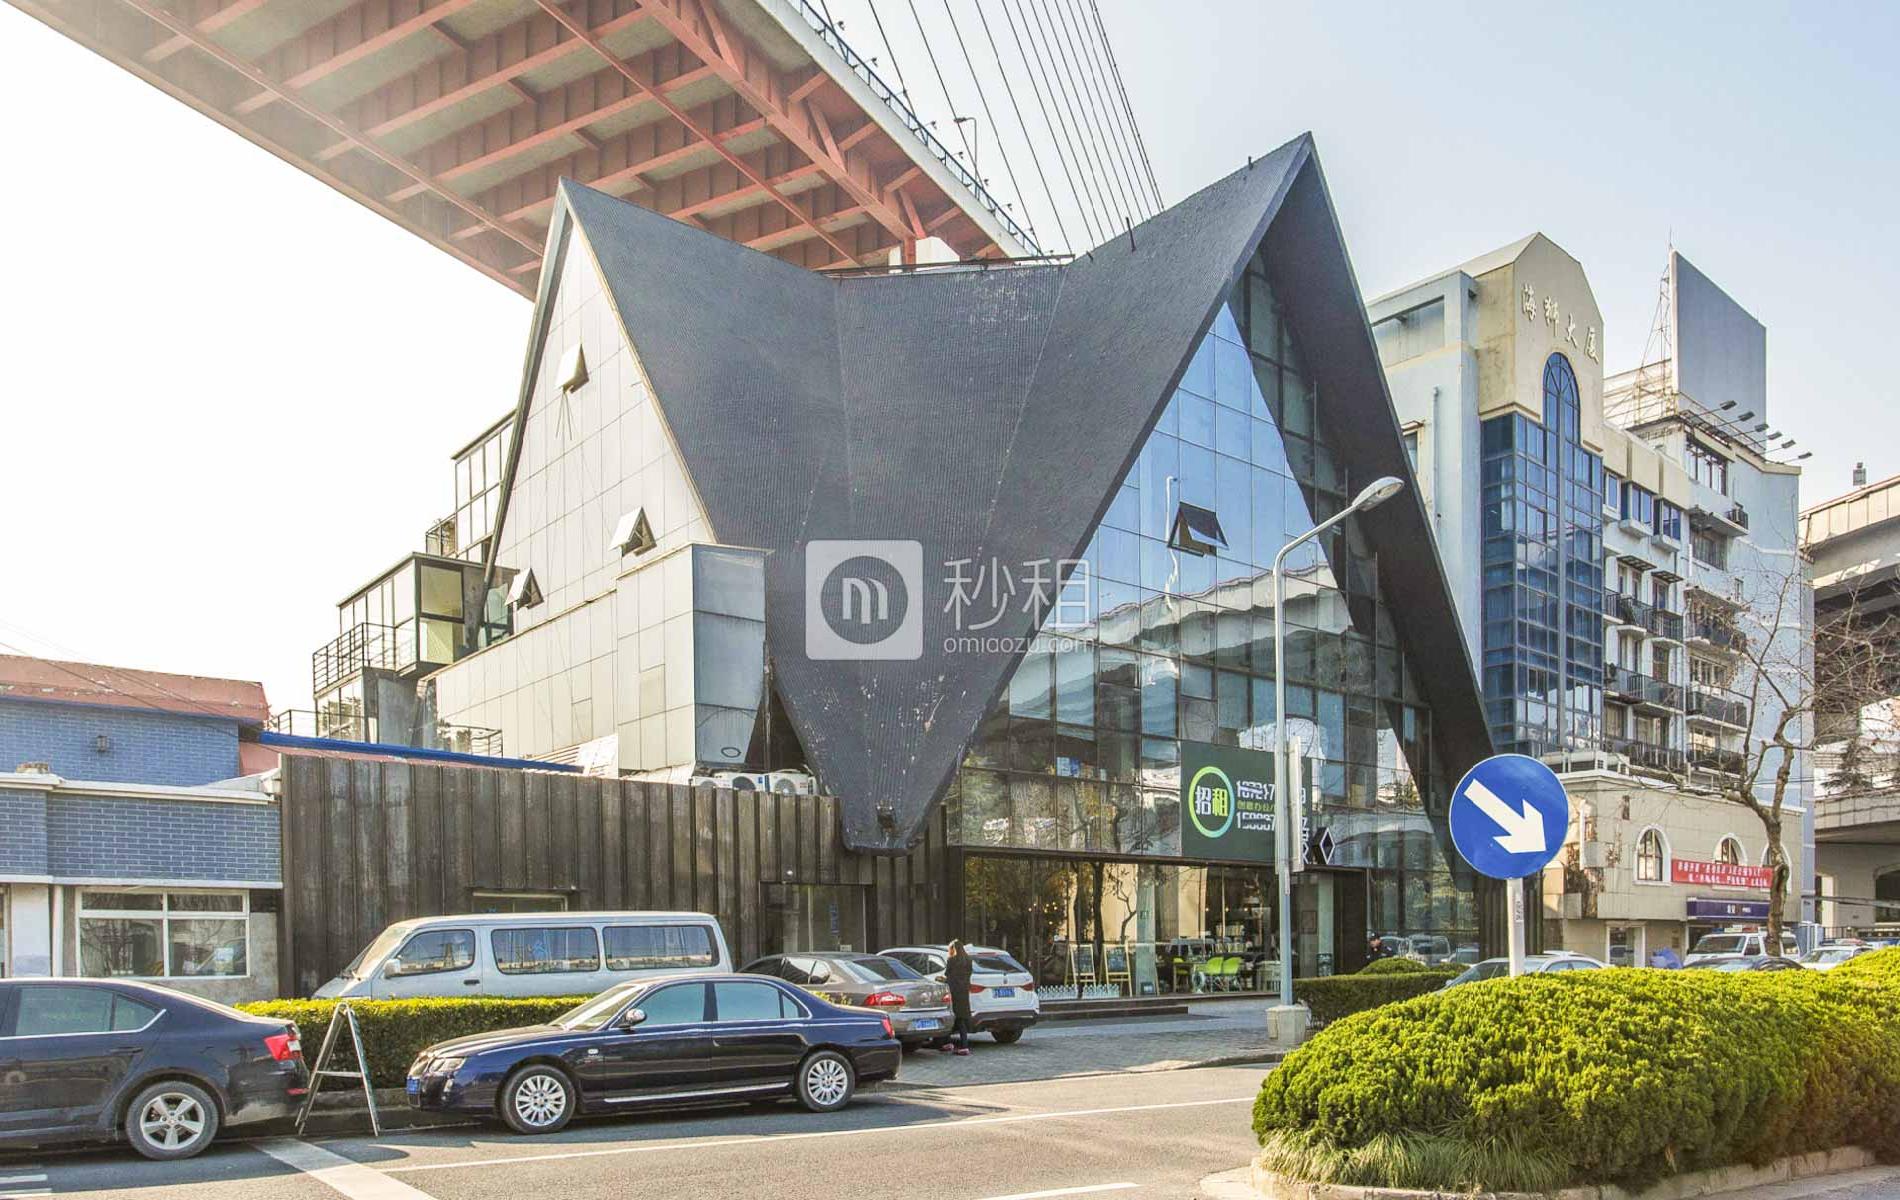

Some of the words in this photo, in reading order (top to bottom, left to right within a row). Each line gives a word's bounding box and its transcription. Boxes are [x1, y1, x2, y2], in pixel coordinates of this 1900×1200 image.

[1521, 283, 1600, 364] 海狮大厦
[1195, 785, 1228, 816] 招租
